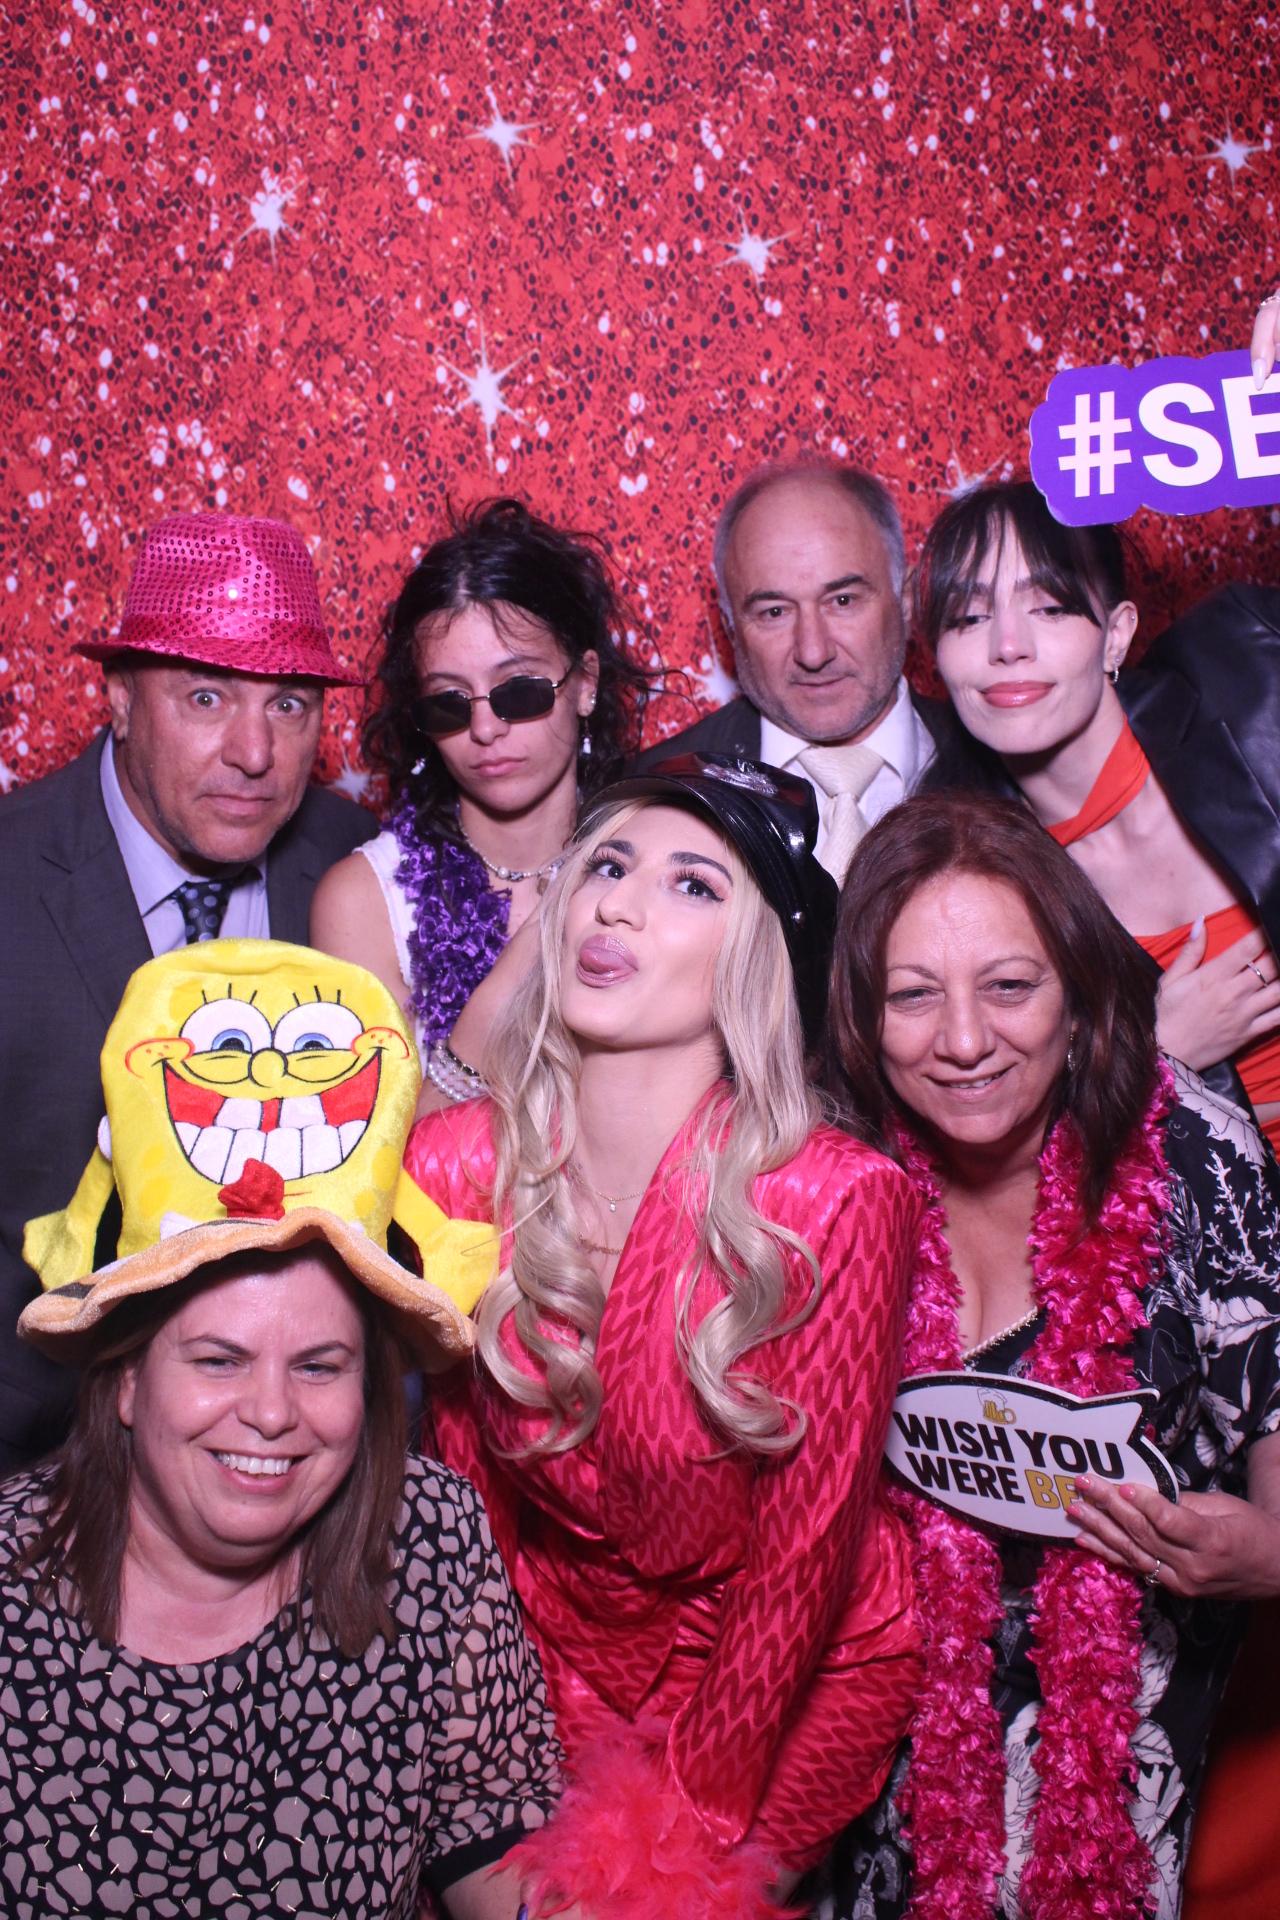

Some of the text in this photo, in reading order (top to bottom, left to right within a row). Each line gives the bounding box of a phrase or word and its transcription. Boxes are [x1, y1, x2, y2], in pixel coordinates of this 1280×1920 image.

[1058, 373, 1280, 498] #SE
[893, 1411, 1125, 1480] WISH YOU
[905, 1451, 1101, 1512] WERE BE
